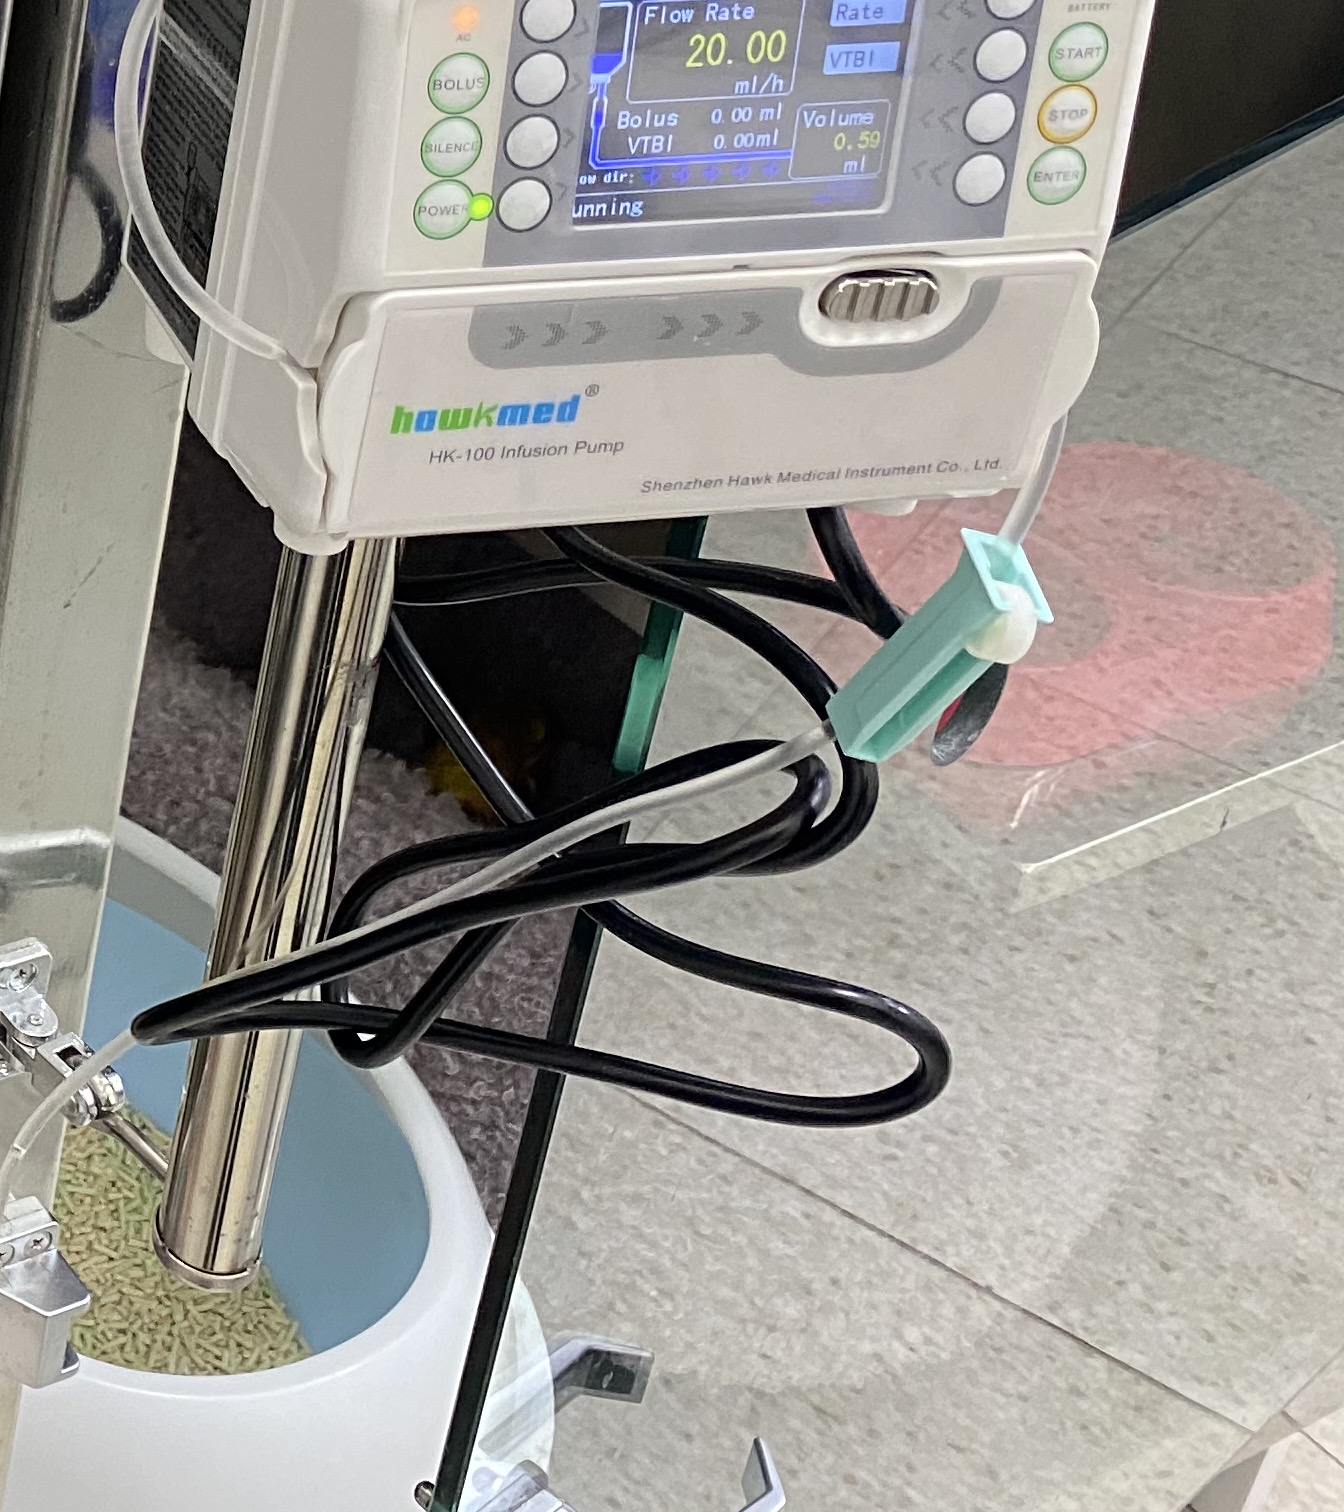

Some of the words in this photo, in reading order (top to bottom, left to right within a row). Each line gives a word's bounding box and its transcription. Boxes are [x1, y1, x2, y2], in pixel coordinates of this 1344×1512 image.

[644, 5, 694, 25] Flow
[705, 2, 755, 22] Rate
[835, 2, 885, 22] Rate
[685, 29, 787, 68] 20.00
[1054, 45, 1103, 60] START
[432, 76, 485, 91] BOLUS
[734, 72, 784, 95] ml/h
[617, 108, 679, 129] Bolus
[710, 106, 753, 124] 0.00
[759, 102, 782, 121] ml
[802, 108, 874, 128] Volume
[1048, 108, 1089, 123] STOP
[424, 141, 481, 154] SILENCE
[843, 154, 866, 174] ml
[579, 174, 597, 185] ow
[603, 170, 634, 185] dir:
[1033, 169, 1080, 183] ENTER
[572, 197, 644, 218] unning
[429, 446, 496, 465] HK-100
[500, 442, 568, 460] Infusion
[574, 440, 625, 456] Pump
[640, 477, 723, 494] Shenzhen
[727, 473, 772, 488] Hawk
[776, 467, 842, 485] Medical
[844, 462, 932, 480] Instrument
